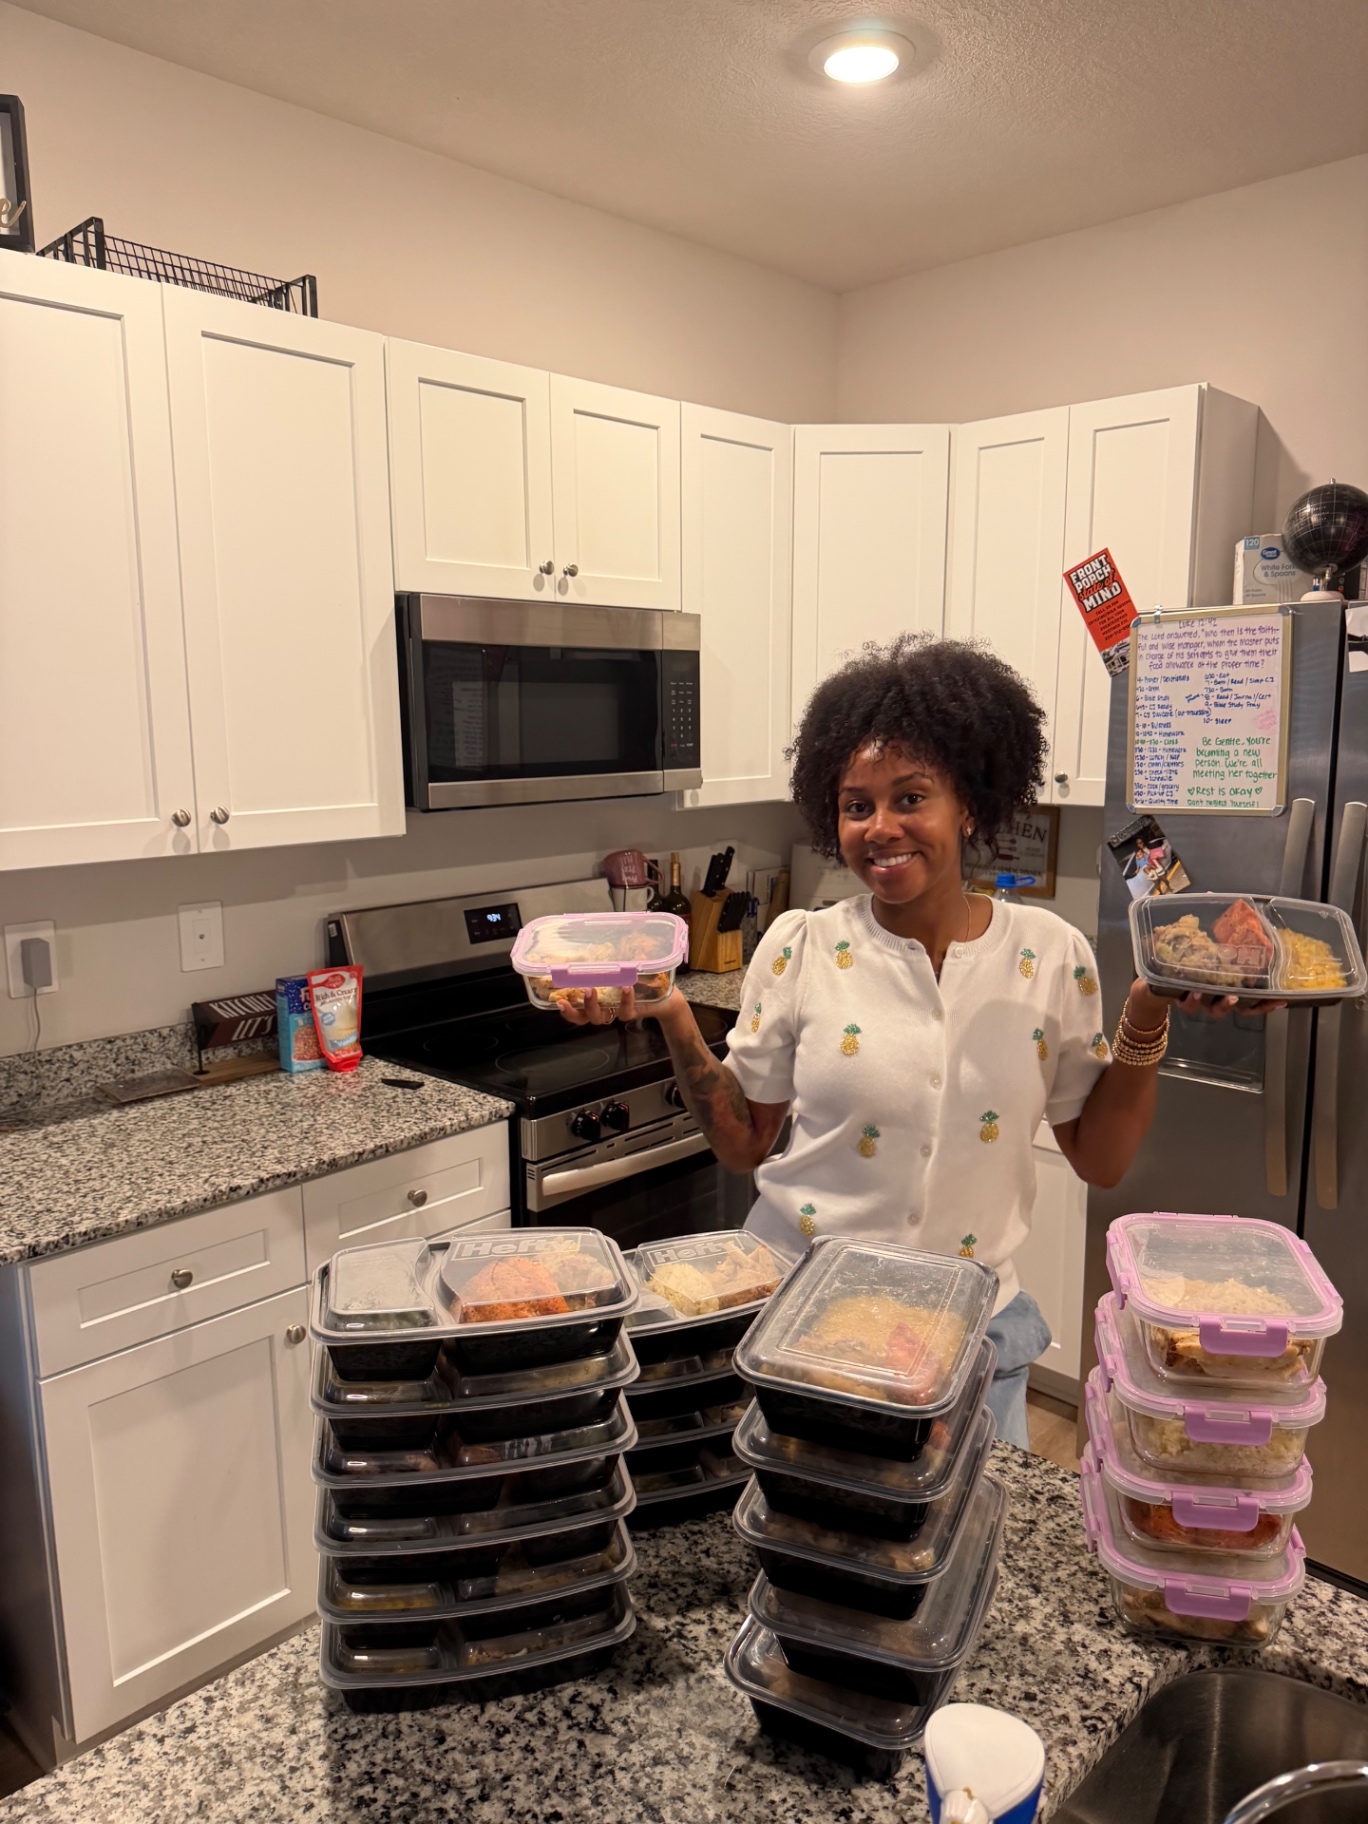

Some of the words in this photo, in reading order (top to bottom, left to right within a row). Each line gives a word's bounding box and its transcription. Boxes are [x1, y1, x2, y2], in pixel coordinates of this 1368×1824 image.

[1246, 538, 1259, 546] 120
[1069, 554, 1108, 584] FRONT
[1261, 564, 1280, 572] White
[1270, 570, 1296, 578] Spoons
[1074, 564, 1113, 594] PORCH
[1079, 579, 1104, 600] state
[1082, 582, 1122, 612] MIND
[1178, 620, 1195, 629] Luke
[1198, 617, 1218, 627] 12:42
[1151, 632, 1164, 640] Lord
[1220, 628, 1235, 636] then
[1244, 626, 1256, 636] the
[1149, 642, 1158, 650] and
[1206, 640, 1226, 648] whom
[1226, 640, 1238, 648] the
[1264, 636, 1280, 646] puts
[1167, 651, 1174, 660] of
[1215, 650, 1222, 658] to
[1240, 649, 1258, 658] them
[1206, 660, 1218, 670] the
[1221, 660, 1242, 670] proper
[1244, 658, 1265, 669] time?
[1202, 736, 1212, 746] Be
[1196, 748, 1230, 760] becoming
[1234, 749, 1239, 757] a
[1243, 748, 1260, 758] new
[1225, 758, 1248, 768] We're
[1252, 758, 1262, 768] all
[1192, 769, 1225, 780] meeting
[1228, 768, 1244, 778] her
[1245, 770, 1278, 783] together
[1196, 786, 1214, 796] Rest
[316, 992, 329, 1001] Rich
[209, 994, 277, 1018] KITCHEN
[232, 1014, 276, 1041] LET'S
[461, 1239, 576, 1257] Hefty
